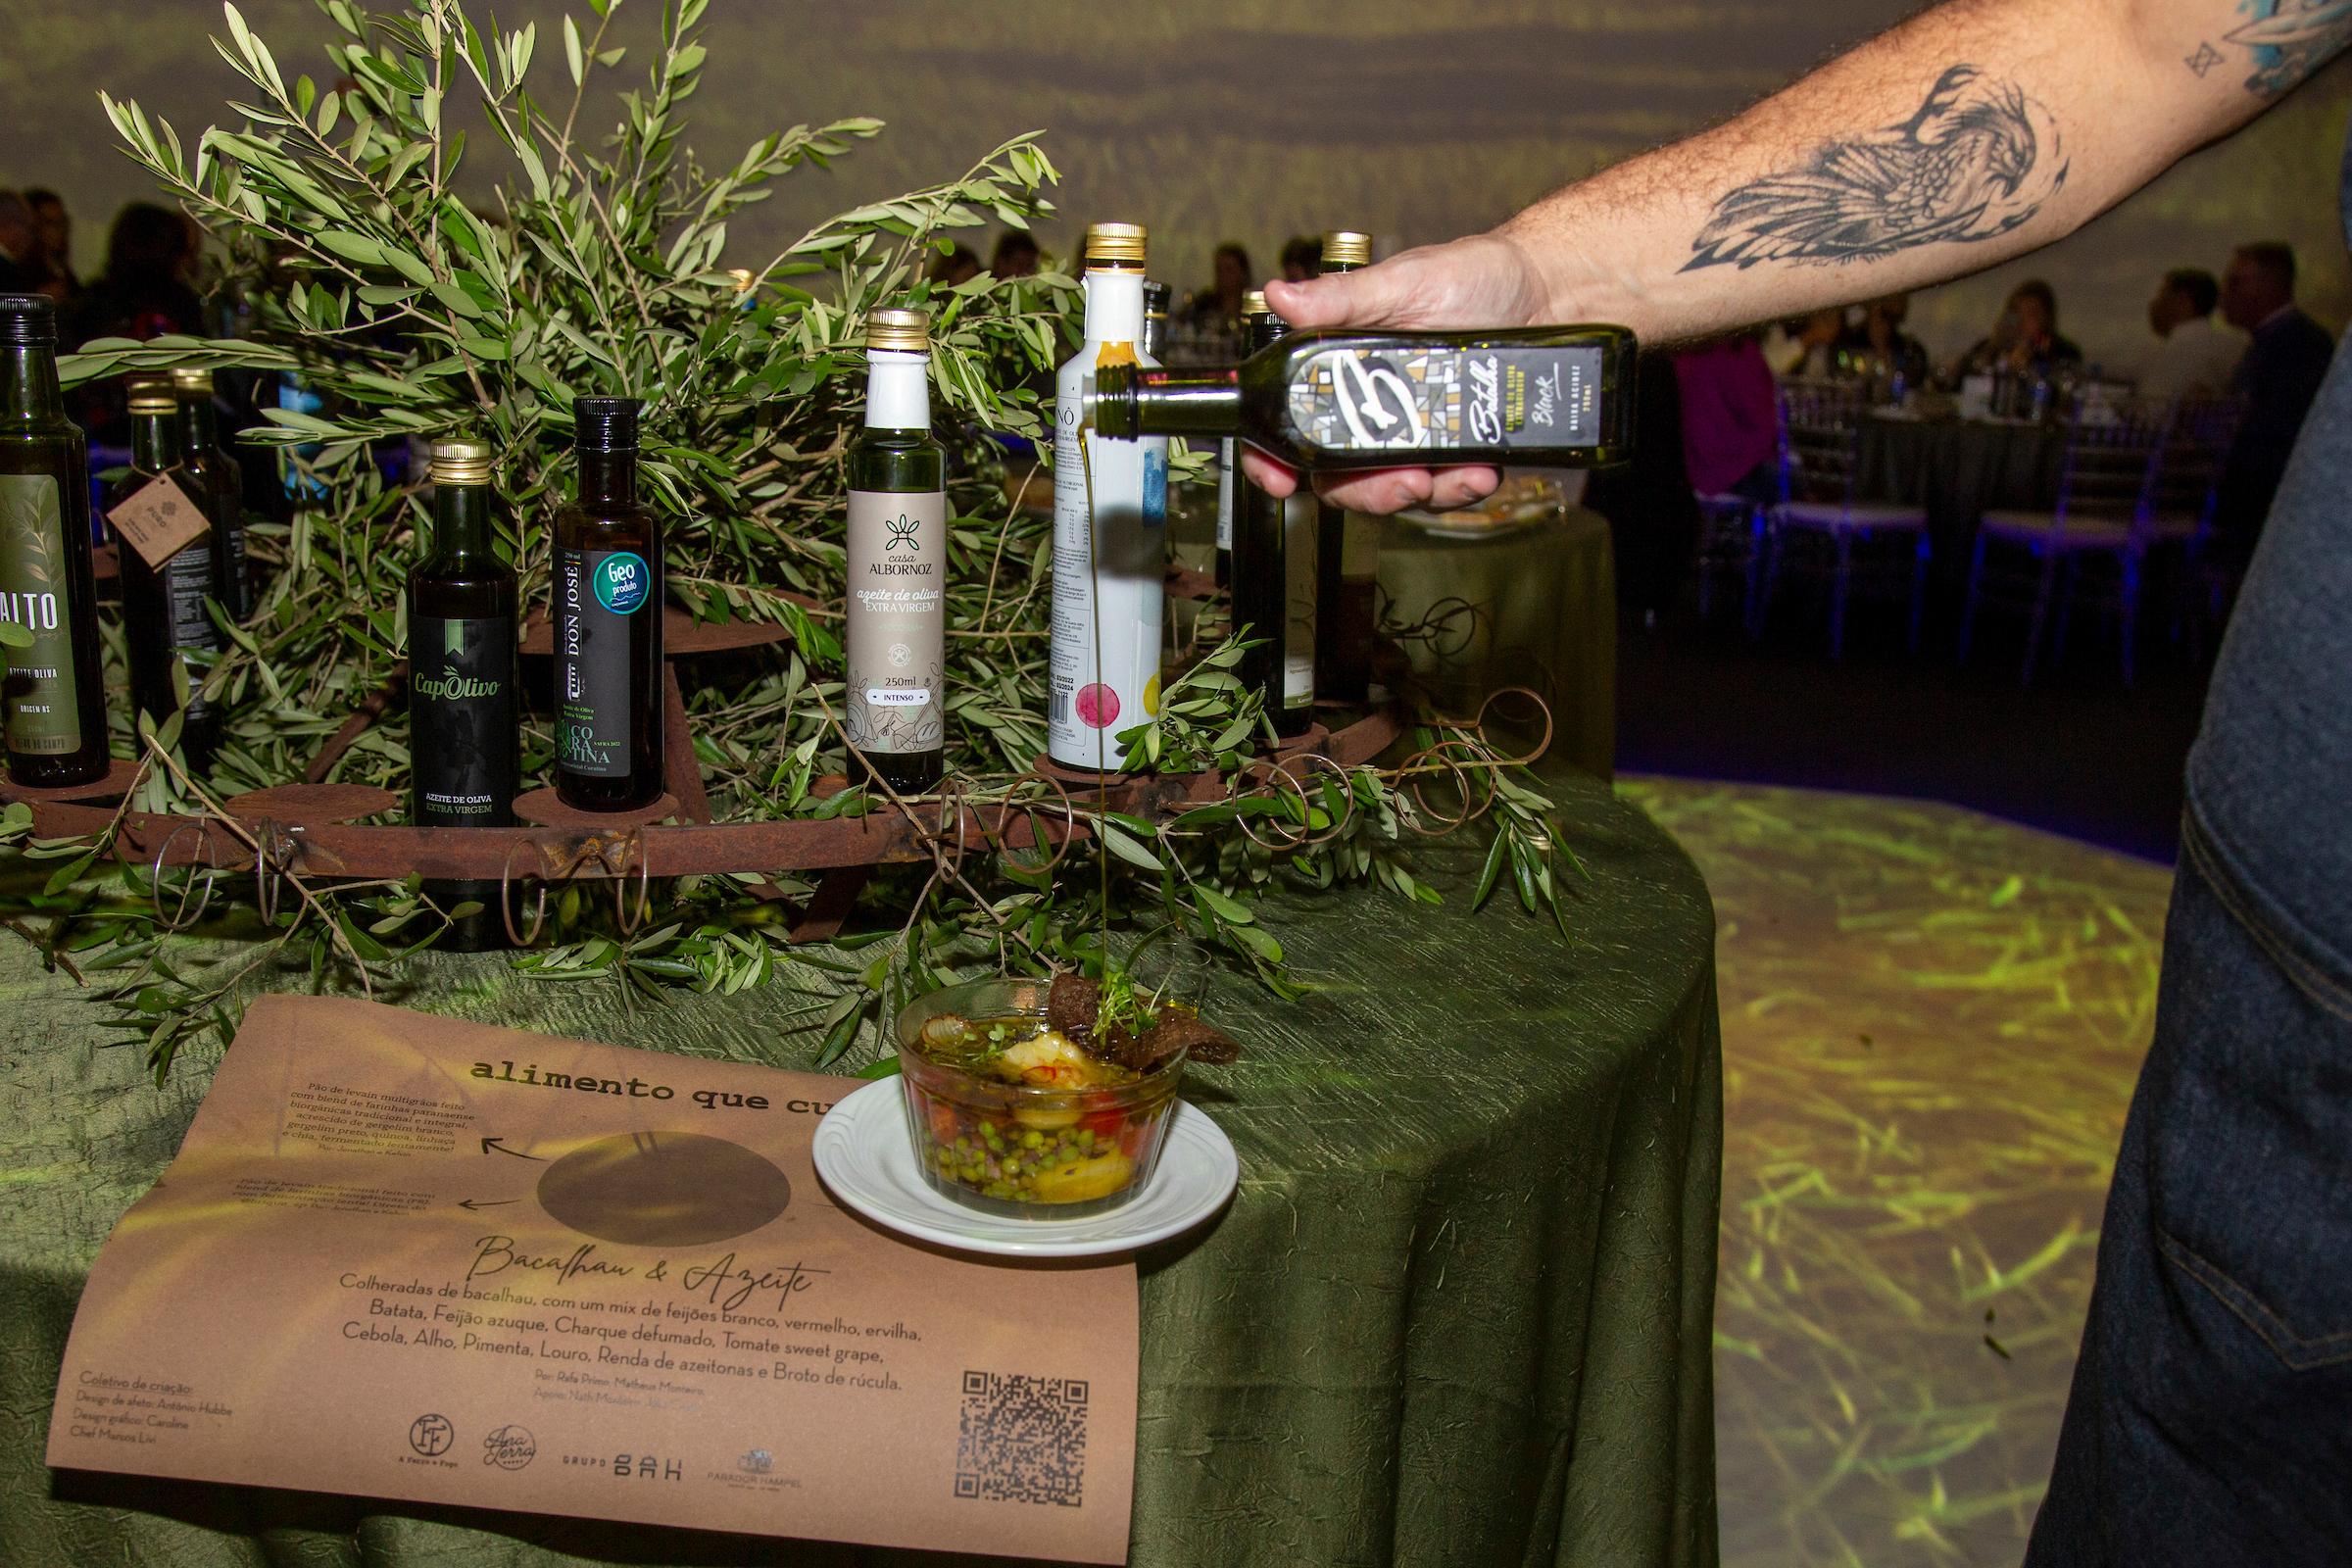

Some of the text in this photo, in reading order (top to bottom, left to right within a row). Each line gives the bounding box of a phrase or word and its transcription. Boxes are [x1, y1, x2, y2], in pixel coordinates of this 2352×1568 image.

[1571, 366, 1580, 399] ACIDEZ
[1469, 355, 1501, 444] Batalha
[1531, 375, 1554, 427] Black
[147, 506, 167, 527] PURO
[869, 563, 932, 576] ALBORNOZ
[888, 554, 917, 564] casa
[608, 563, 635, 583] Geo
[612, 581, 637, 598] produto
[857, 588, 939, 604] azeite de oliva
[564, 566, 581, 657] DON JOSÉ
[865, 602, 935, 613] EXTRA VIRGEM
[34, 668, 58, 678] OLIVA
[885, 676, 916, 687] 250ml
[415, 670, 501, 701] CapOlivo
[883, 694, 914, 703] INTENSO
[426, 793, 492, 804] AZEITE DE OLIVA
[426, 803, 492, 814] EXTRA VIRGEM
[308, 1083, 327, 1092] Pão
[346, 1088, 377, 1099] levain
[380, 1094, 438, 1107] multigrãos
[438, 1102, 466, 1111] feito
[469, 1060, 835, 1116] alimento que cu
[317, 1094, 348, 1104] blend
[366, 1102, 410, 1113] farinhas
[412, 1108, 475, 1120] paranaense
[296, 1112, 347, 1125] acrescido
[365, 1122, 413, 1133] gergelim
[416, 1126, 454, 1137] branco,
[355, 1109, 413, 1123] tradicional
[422, 1118, 467, 1130] integral,
[286, 1121, 455, 1146] gergelim preto, quinoa, linhaça
[291, 1131, 317, 1141] chia,
[320, 1134, 384, 1147] fermentado
[387, 1141, 455, 1152] lentamente!
[466, 1235, 831, 1311] Bacalhau & Azeite
[339, 1272, 922, 1342] Colheradas de bacalhau, com um mix de feijões branco, vermelho, ervilha,
[368, 1298, 885, 1366] Batata, Feijão azuque, Charque defumado, Tomate sweet grape,
[343, 1321, 903, 1392] Cebola, Alho, Pimenta, Louro, Renda de azeitonas e Broto de rúcula.
[79, 1370, 129, 1388] Coletivo
[131, 1375, 147, 1390] de
[76, 1390, 110, 1406] Design
[112, 1394, 125, 1405] de
[73, 1407, 108, 1425] Design
[147, 1414, 189, 1430] Caroline
[70, 1424, 96, 1438] Chef
[99, 1428, 136, 1444] Marcos
[563, 1453, 683, 1482] GRUPO BAH
